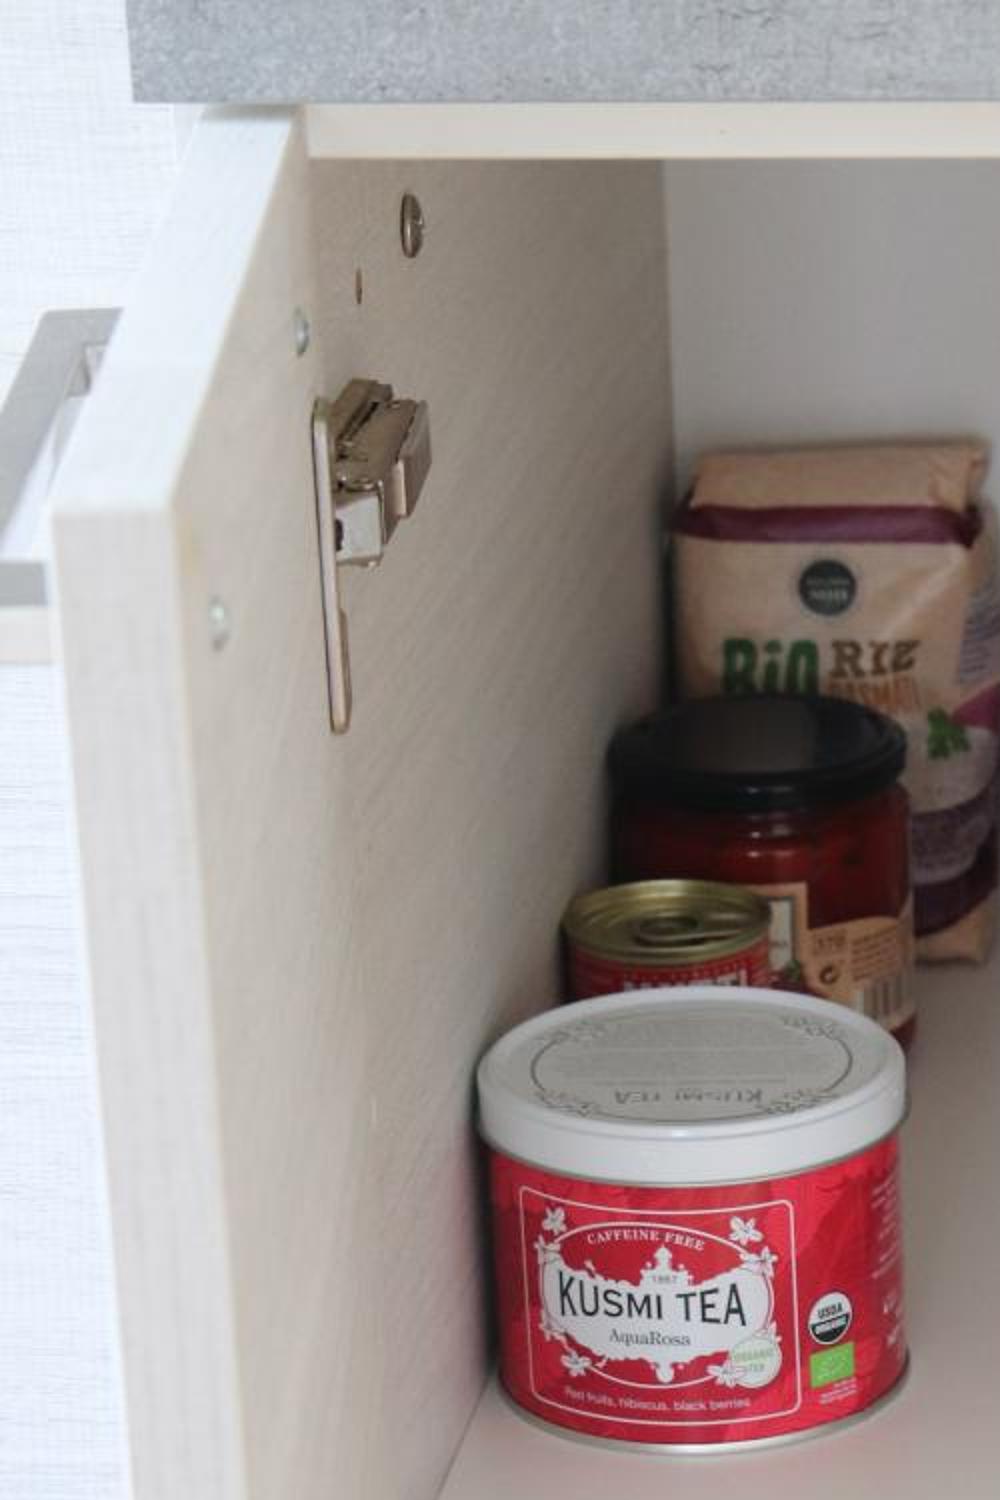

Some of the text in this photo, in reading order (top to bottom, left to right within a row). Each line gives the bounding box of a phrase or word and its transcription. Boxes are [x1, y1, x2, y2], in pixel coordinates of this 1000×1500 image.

[587, 1228, 705, 1252] CAFFEINE FREE
[559, 1269, 748, 1327] KUSMI TEA
[818, 1301, 844, 1320] USDA
[608, 1327, 692, 1348] AquaRosa
